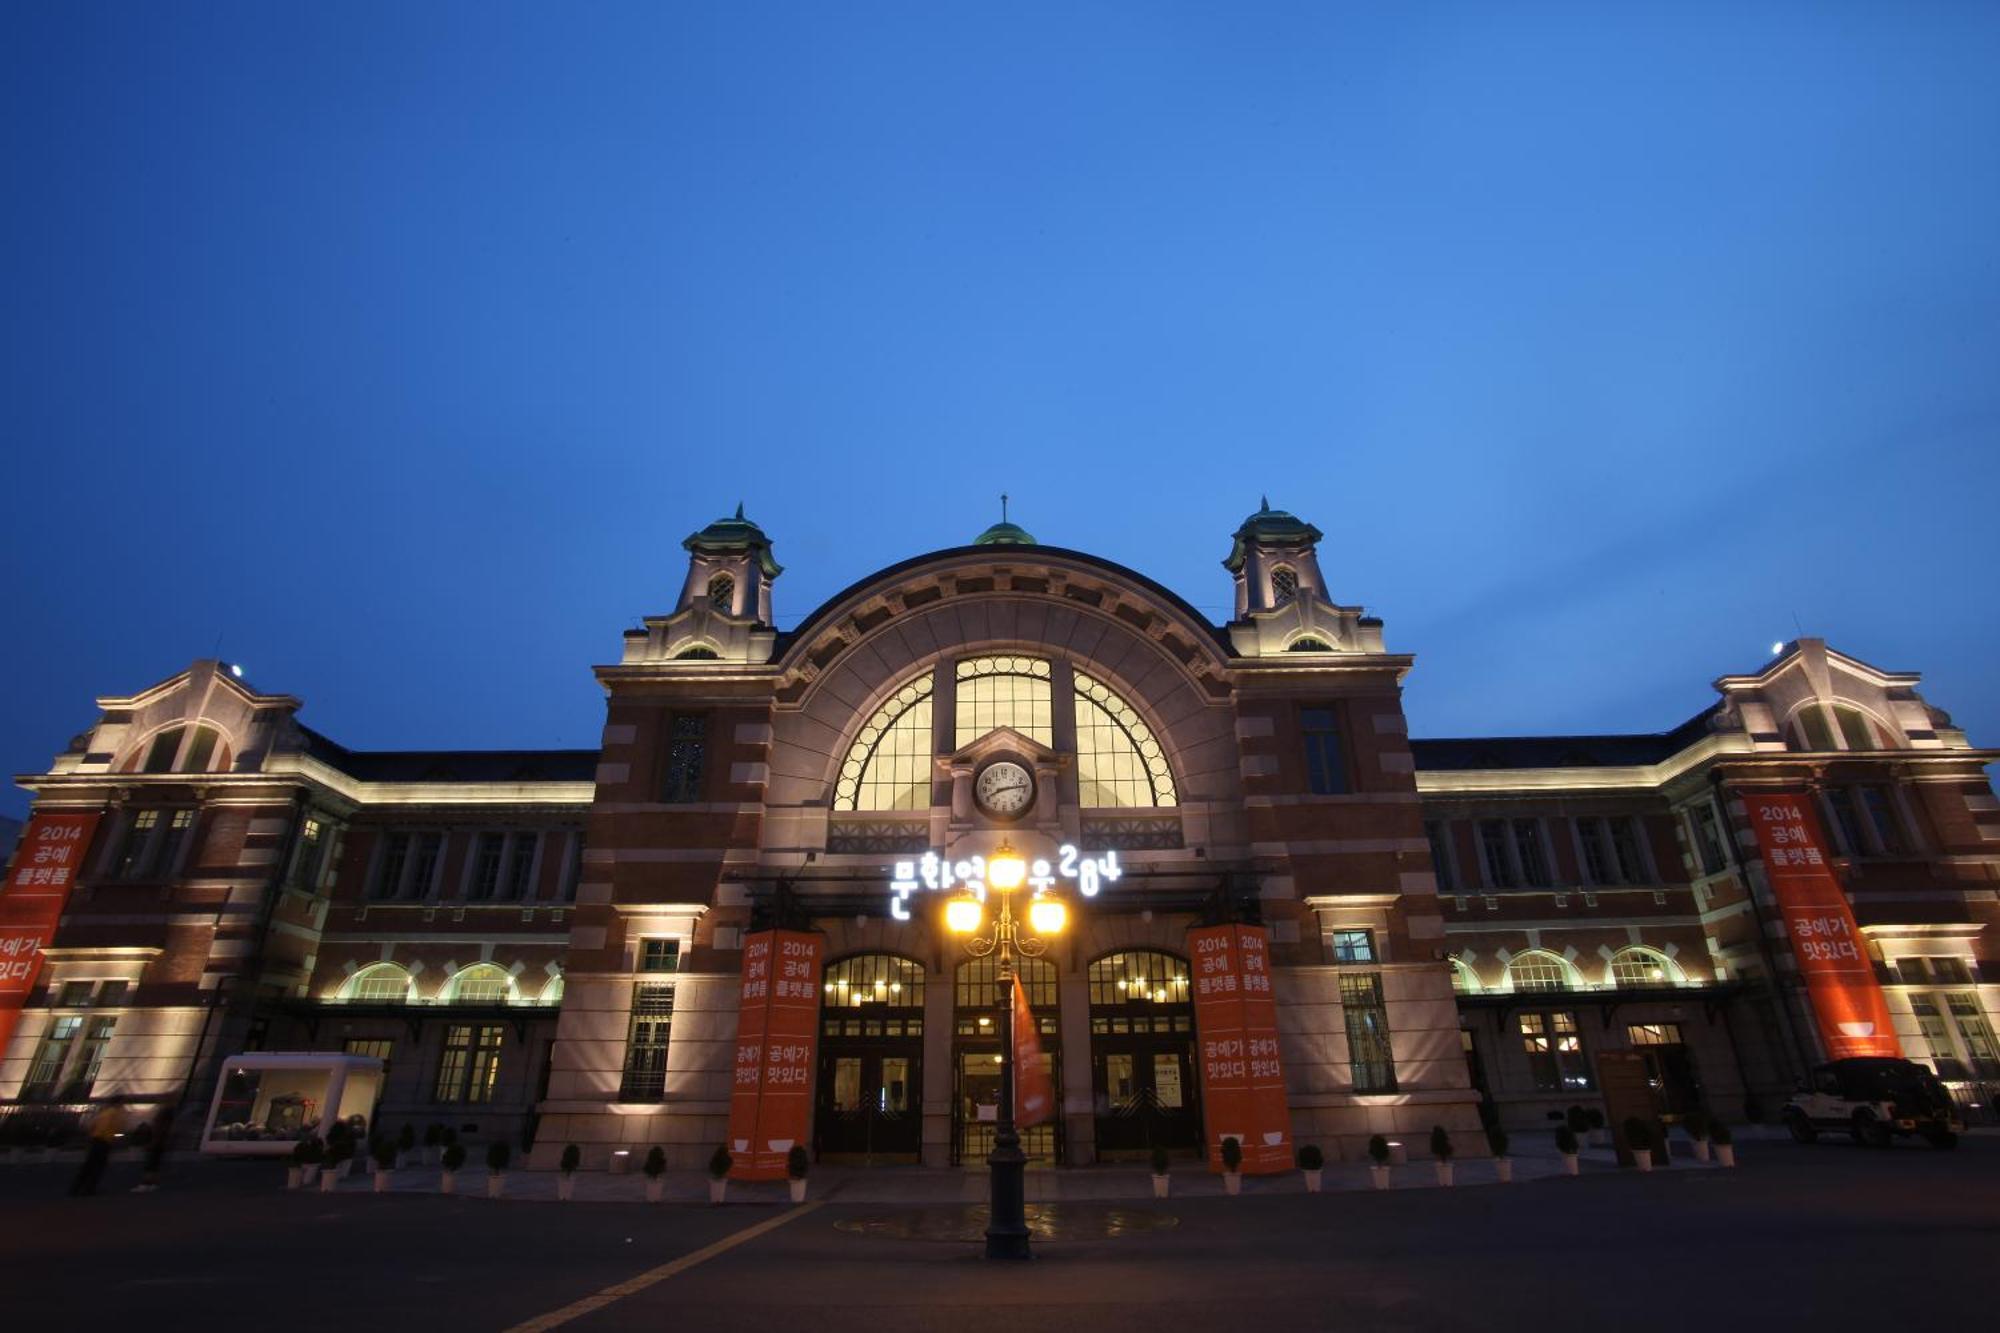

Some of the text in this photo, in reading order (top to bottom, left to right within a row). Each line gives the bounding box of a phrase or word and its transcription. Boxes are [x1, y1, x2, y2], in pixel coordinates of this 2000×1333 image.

[1760, 806, 1802, 821] 2014
[38, 826, 82, 841] 2014
[1771, 825, 1808, 844] 공예
[34, 845, 70, 863] 공예
[1770, 847, 1824, 866] 플랫폼
[16, 868, 69, 885] 플랫폼
[1794, 916, 1849, 937] 공예가
[783, 942, 814, 957] 2014
[1197, 937, 1228, 953] 2014
[1802, 940, 1859, 960] 맛있다
[784, 960, 811, 978] 공예
[1202, 954, 1228, 973] 공예
[777, 980, 815, 998] 플랫폼
[1199, 975, 1237, 994] 플랫폼
[769, 1045, 809, 1063] 공예가
[1205, 1039, 1244, 1058] 공예가
[768, 1066, 807, 1084] 맛있다
[1208, 1061, 1246, 1080] 맛있다
